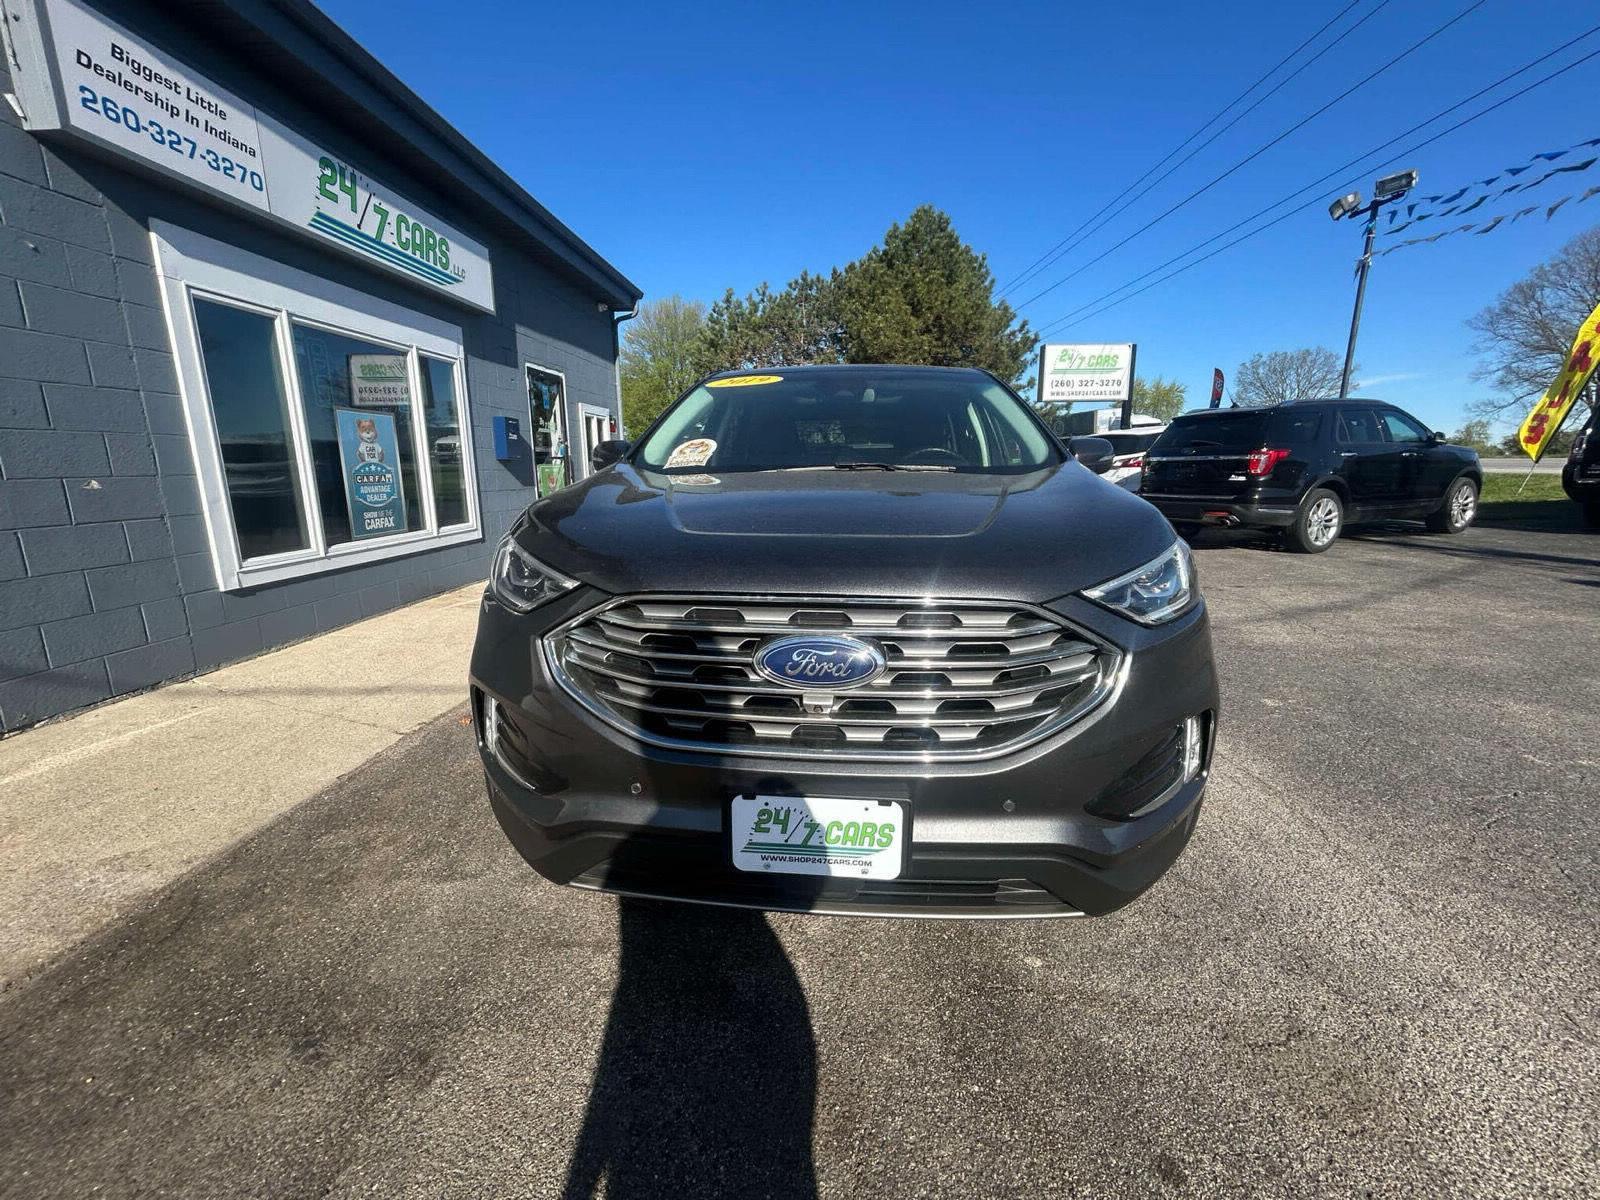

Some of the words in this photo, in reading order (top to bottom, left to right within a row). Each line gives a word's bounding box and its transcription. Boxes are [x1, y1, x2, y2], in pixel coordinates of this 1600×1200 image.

[111, 43, 181, 95] Biggest
[186, 87, 227, 121] Little
[76, 49, 180, 118] Dealership
[185, 109, 200, 129] In
[204, 120, 256, 158] Indiana
[78, 85, 264, 192] 260-327-3270
[395, 213, 450, 271] CARS
[1087, 353, 1120, 368] CARS
[1050, 379, 1075, 389] (260)
[1078, 379, 1122, 388] 327-3270
[364, 516, 395, 530] CARFAX
[784, 648, 852, 678] Ford
[824, 819, 896, 848] CARS
[760, 854, 873, 867] WWW.SHOP247CARS.COM
